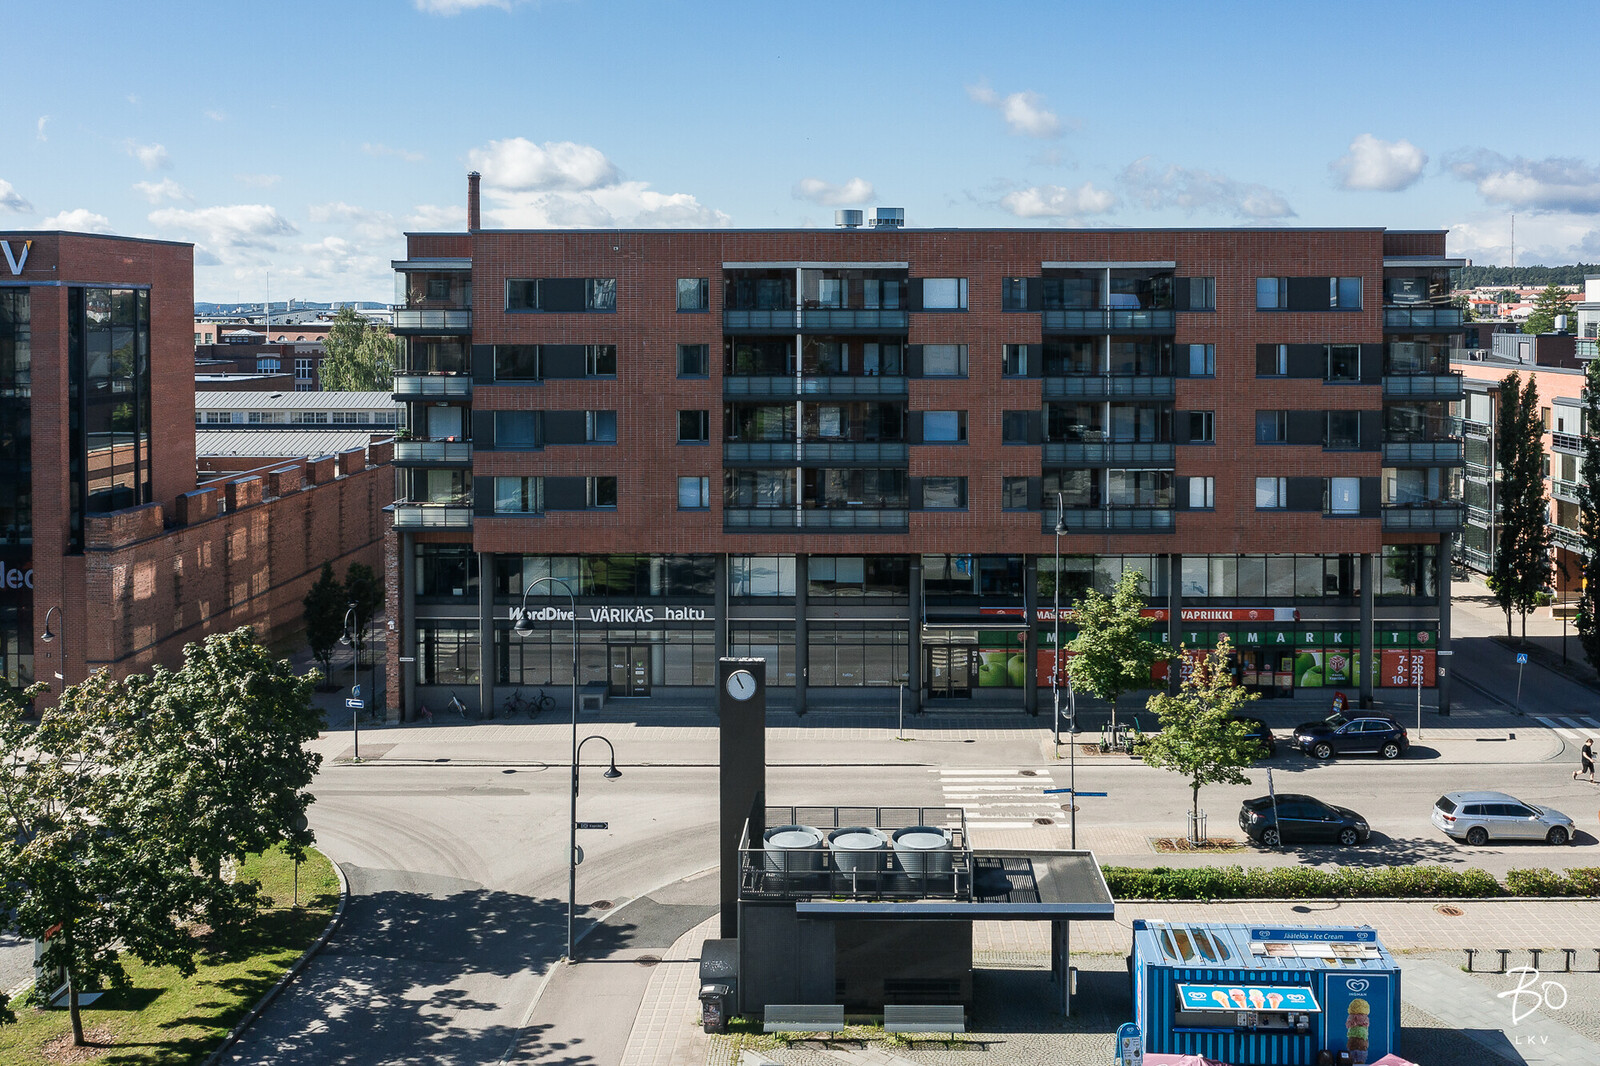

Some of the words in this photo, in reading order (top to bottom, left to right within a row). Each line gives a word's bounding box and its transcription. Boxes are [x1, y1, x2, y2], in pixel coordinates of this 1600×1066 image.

[590, 606, 654, 623] VÄRIKÄS
[665, 607, 705, 621] haltu
[1181, 611, 1233, 620] VAPRIIKKI
[1411, 655, 1424, 664] 22
[1411, 665, 1424, 674] 22
[1284, 932, 1309, 940] Jäätelöä
